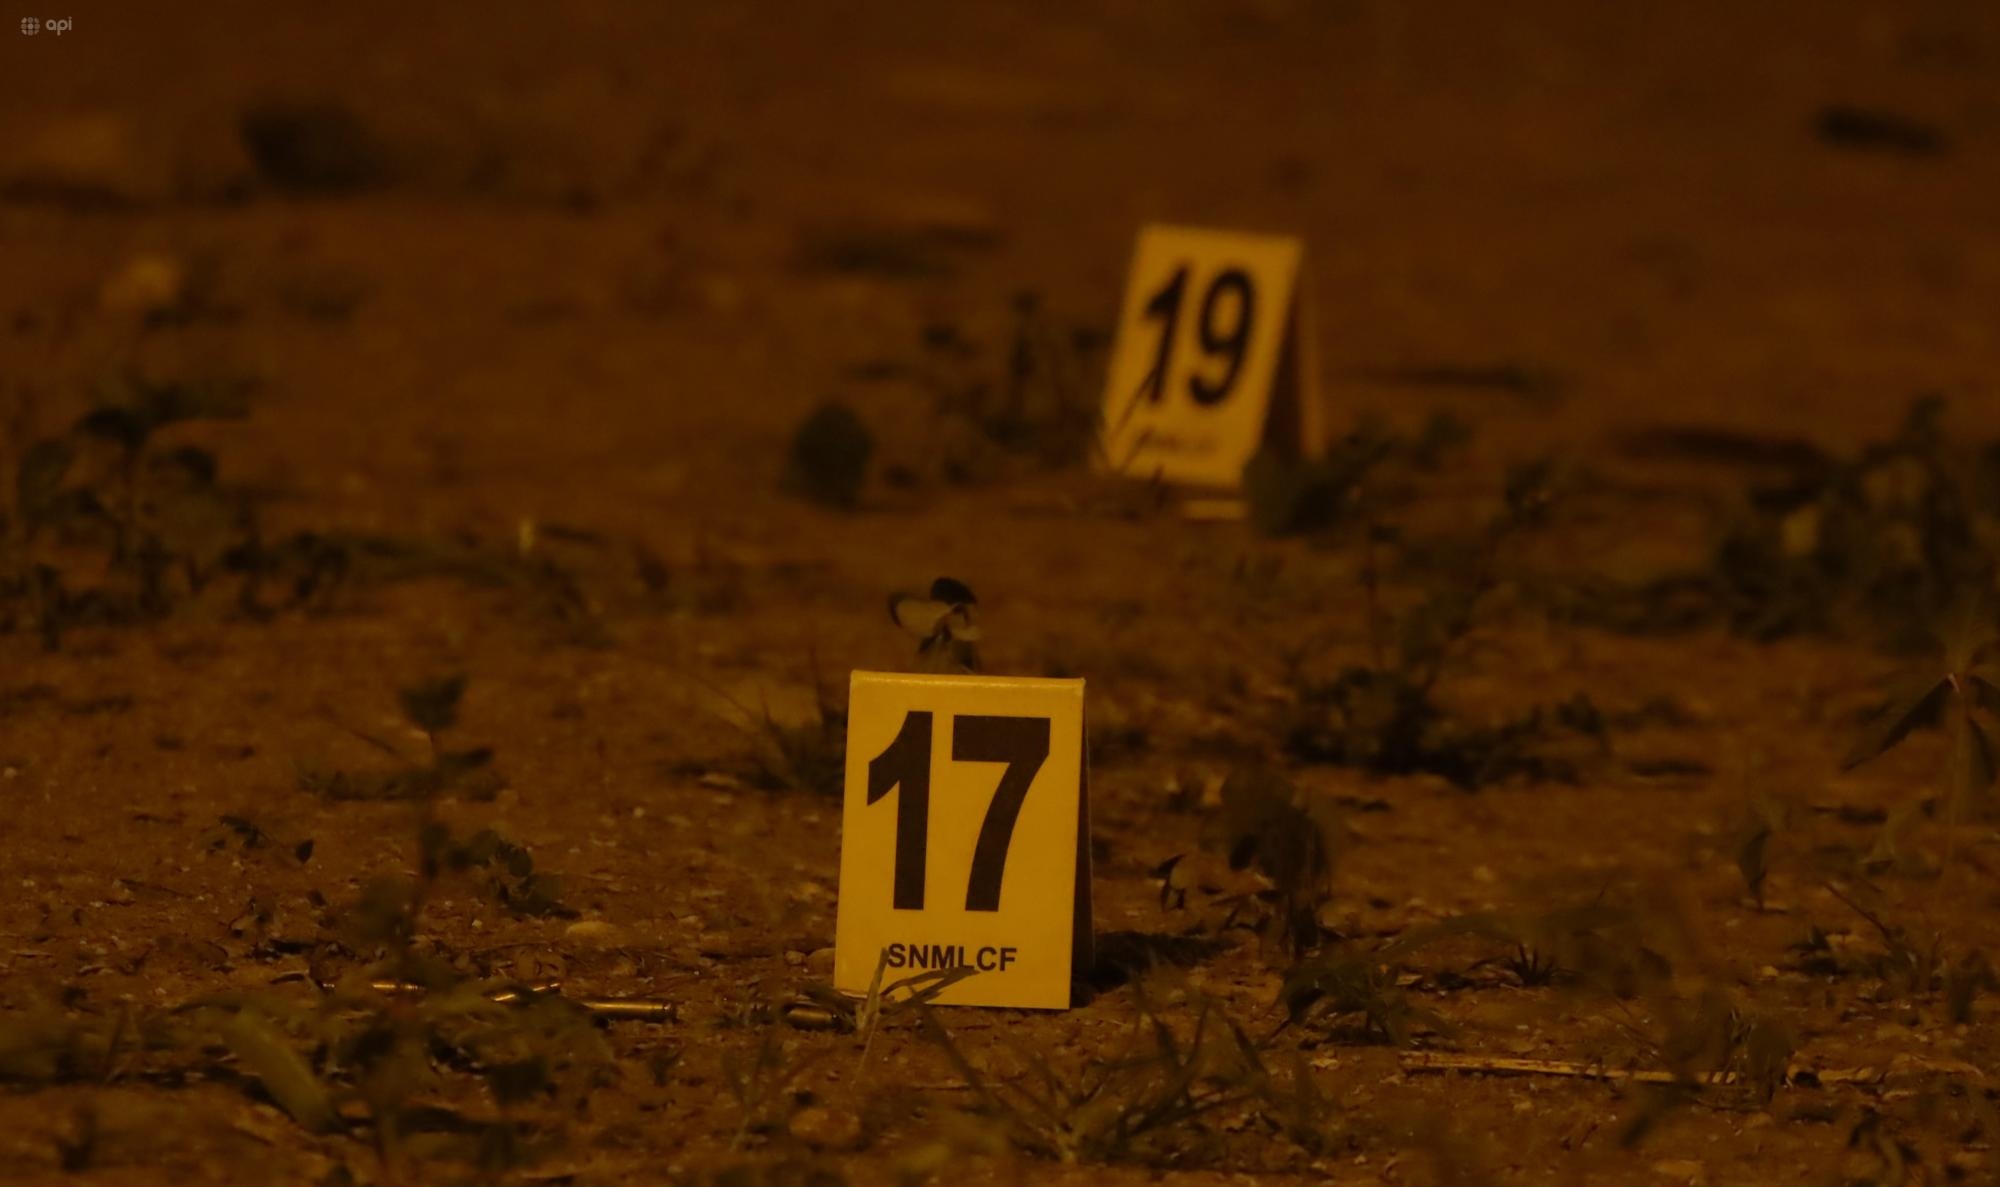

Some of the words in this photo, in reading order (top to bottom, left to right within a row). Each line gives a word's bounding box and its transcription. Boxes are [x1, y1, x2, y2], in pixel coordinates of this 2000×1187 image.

[1145, 265, 1254, 405] 19
[867, 710, 1051, 912] 17
[886, 942, 1018, 972] SNMLCF
